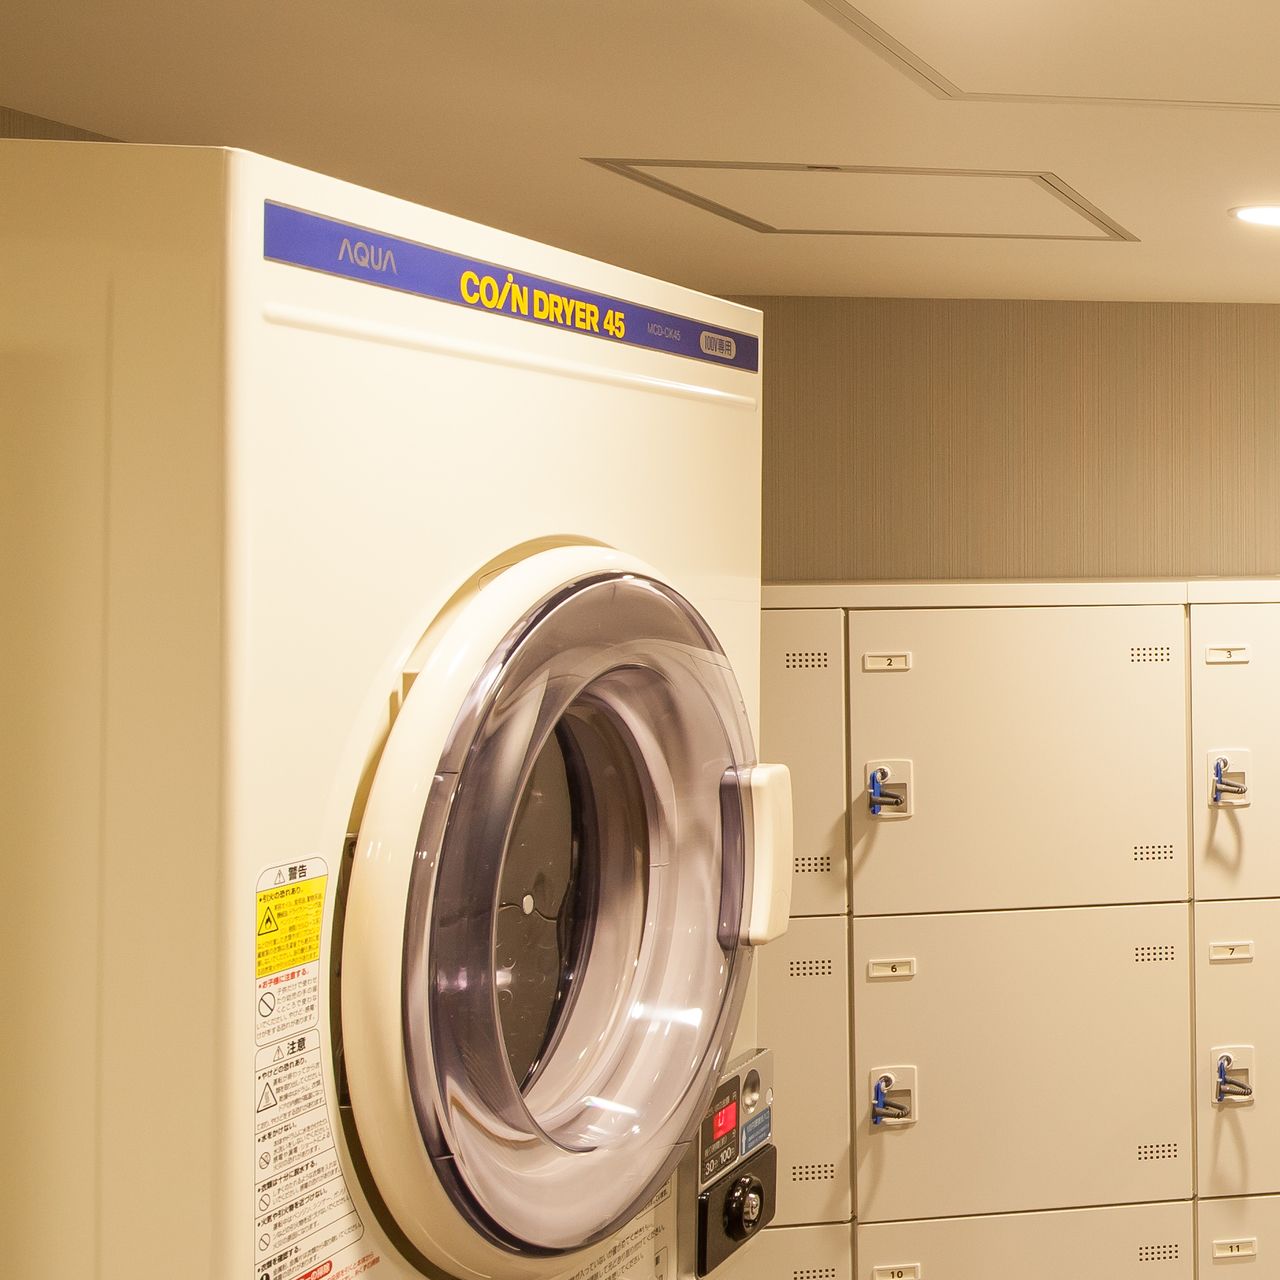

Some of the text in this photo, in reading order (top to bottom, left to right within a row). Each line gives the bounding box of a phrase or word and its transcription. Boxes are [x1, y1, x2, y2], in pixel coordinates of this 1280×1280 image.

[338, 238, 398, 275] AQUA
[533, 289, 599, 332] DRYER
[603, 309, 625, 340] 45
[1226, 650, 1233, 659] 3
[886, 658, 893, 667] 2
[288, 865, 308, 881] 警告
[1228, 948, 1235, 956] 7
[890, 964, 898, 973] 6
[287, 1037, 306, 1055] 注意
[1229, 1244, 1240, 1253] 11
[890, 1270, 904, 1279] 10
